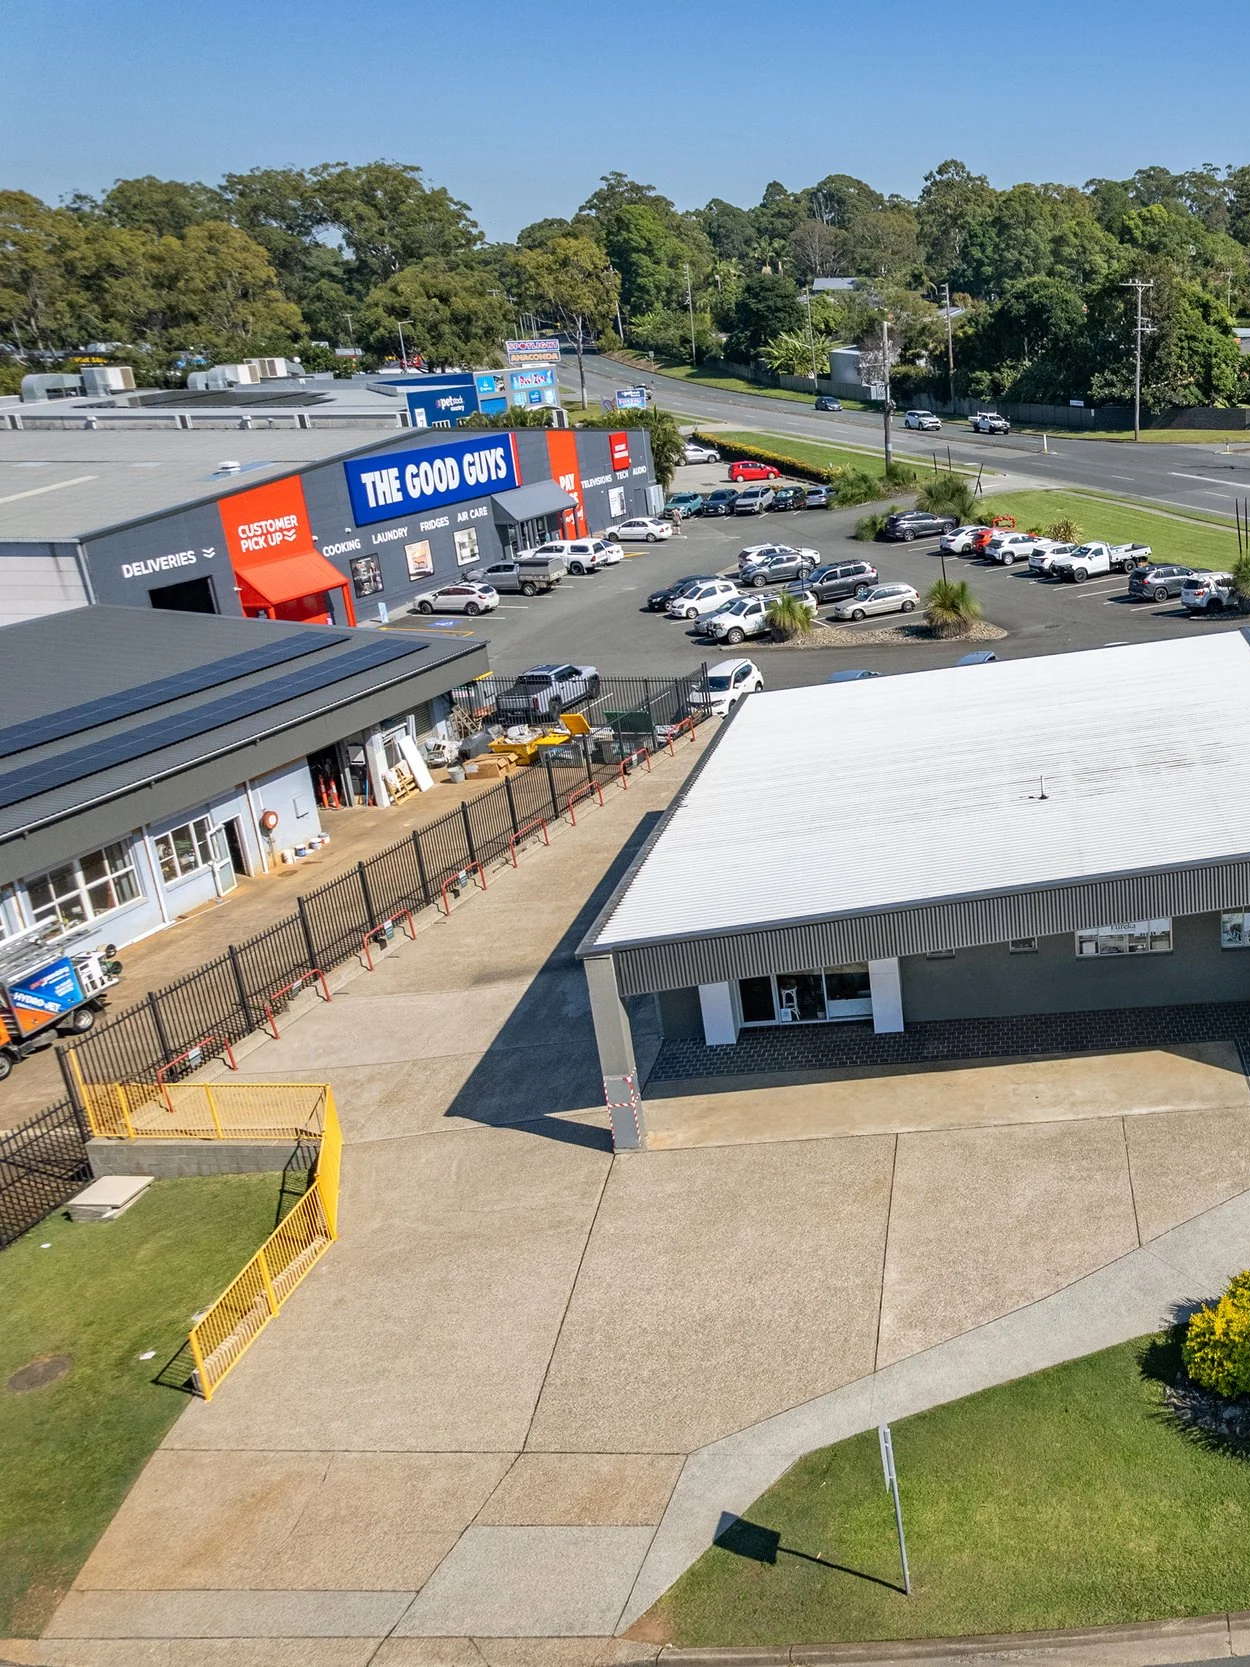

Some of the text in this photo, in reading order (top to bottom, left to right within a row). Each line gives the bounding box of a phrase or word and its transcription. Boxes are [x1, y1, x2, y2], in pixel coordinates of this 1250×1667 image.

[507, 341, 558, 350] SPOTLIGHT
[510, 352, 558, 362] ANACONDA
[360, 447, 507, 508] THE GOOD GUYS
[558, 473, 575, 491] PAY
[581, 465, 647, 490] TELEVISIONS TECH AUDIO
[237, 515, 298, 539] CUSTOMER
[322, 506, 488, 557] COOKING LAUNDRY FRIDGES AIR CARE
[240, 532, 284, 553] PICK UP
[121, 550, 197, 578] DELIVERIES
[1111, 922, 1136, 931] Eureka
[13, 992, 62, 1013] HYDRO-JET
